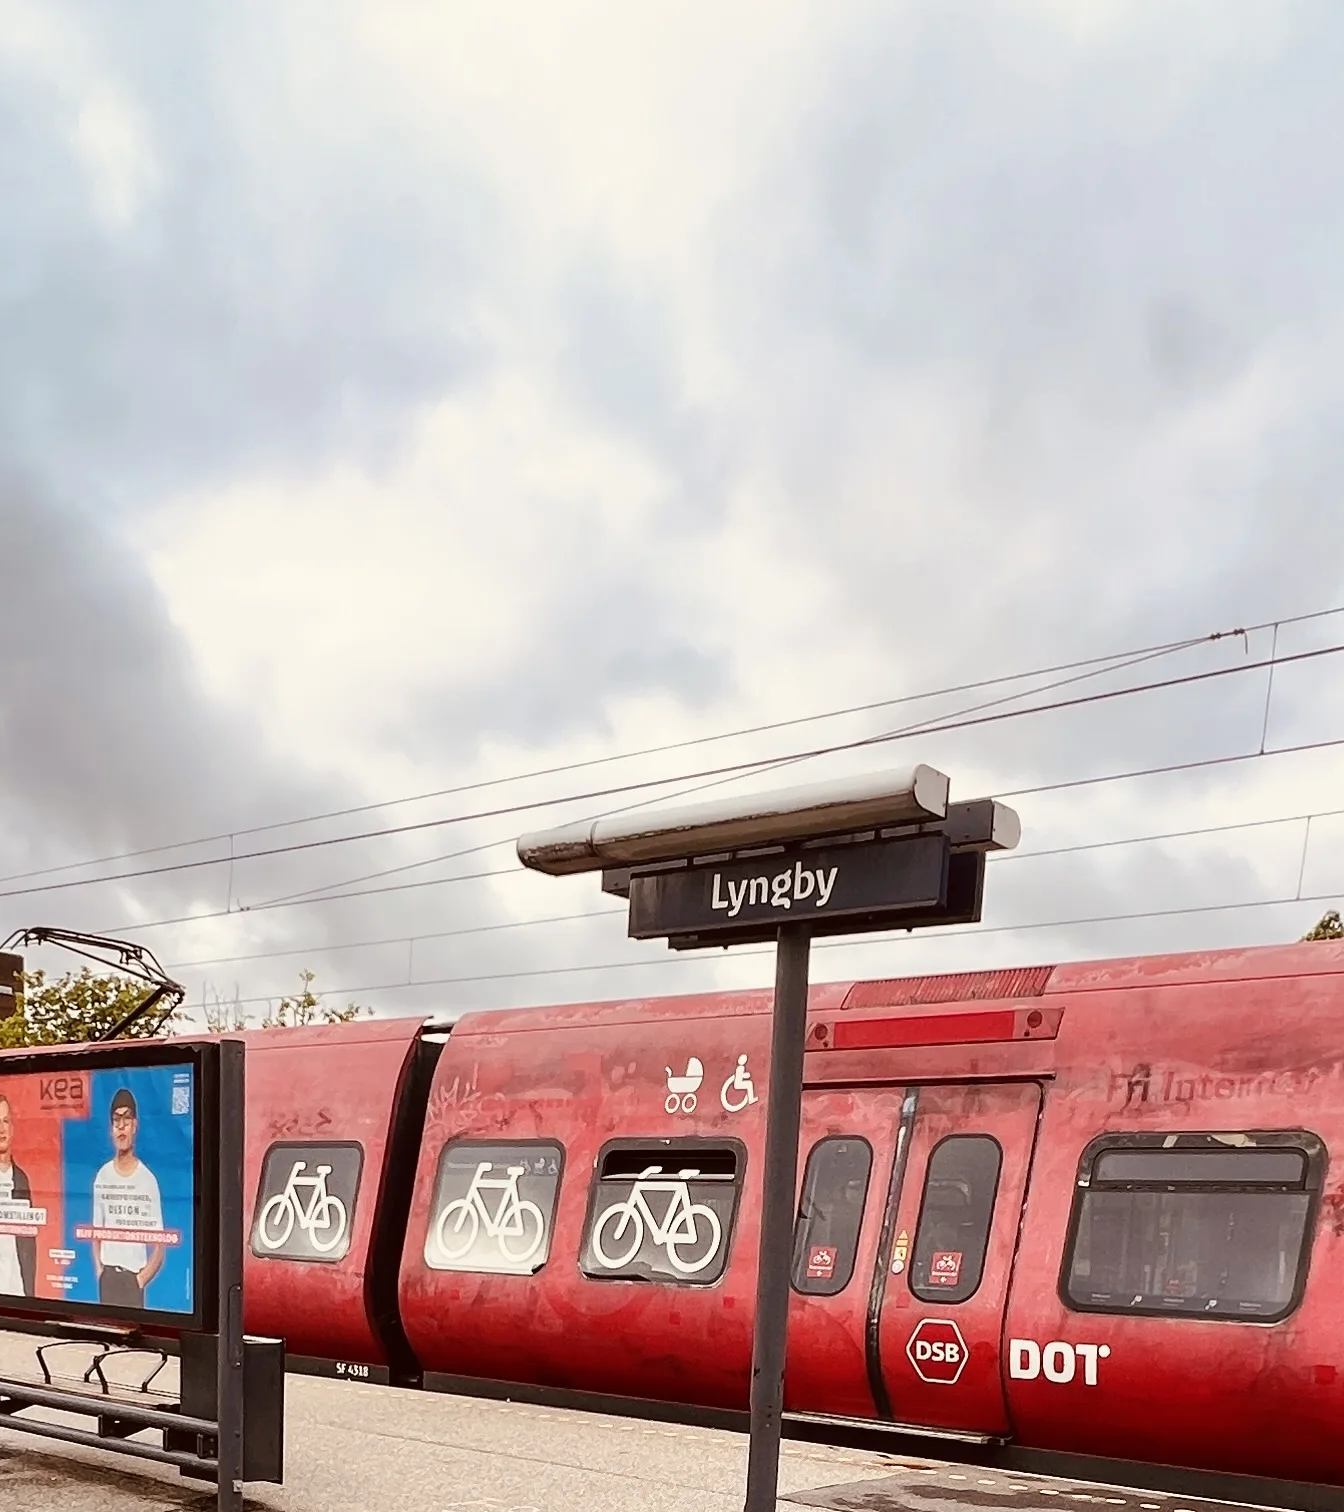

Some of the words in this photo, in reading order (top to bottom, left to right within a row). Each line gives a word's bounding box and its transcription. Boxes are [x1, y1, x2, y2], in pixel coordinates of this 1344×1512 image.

[711, 861, 838, 917] Lyngby
[40, 1077, 84, 1101] kea
[915, 1340, 960, 1363] DSB
[1009, 1338, 1111, 1386] DOT
